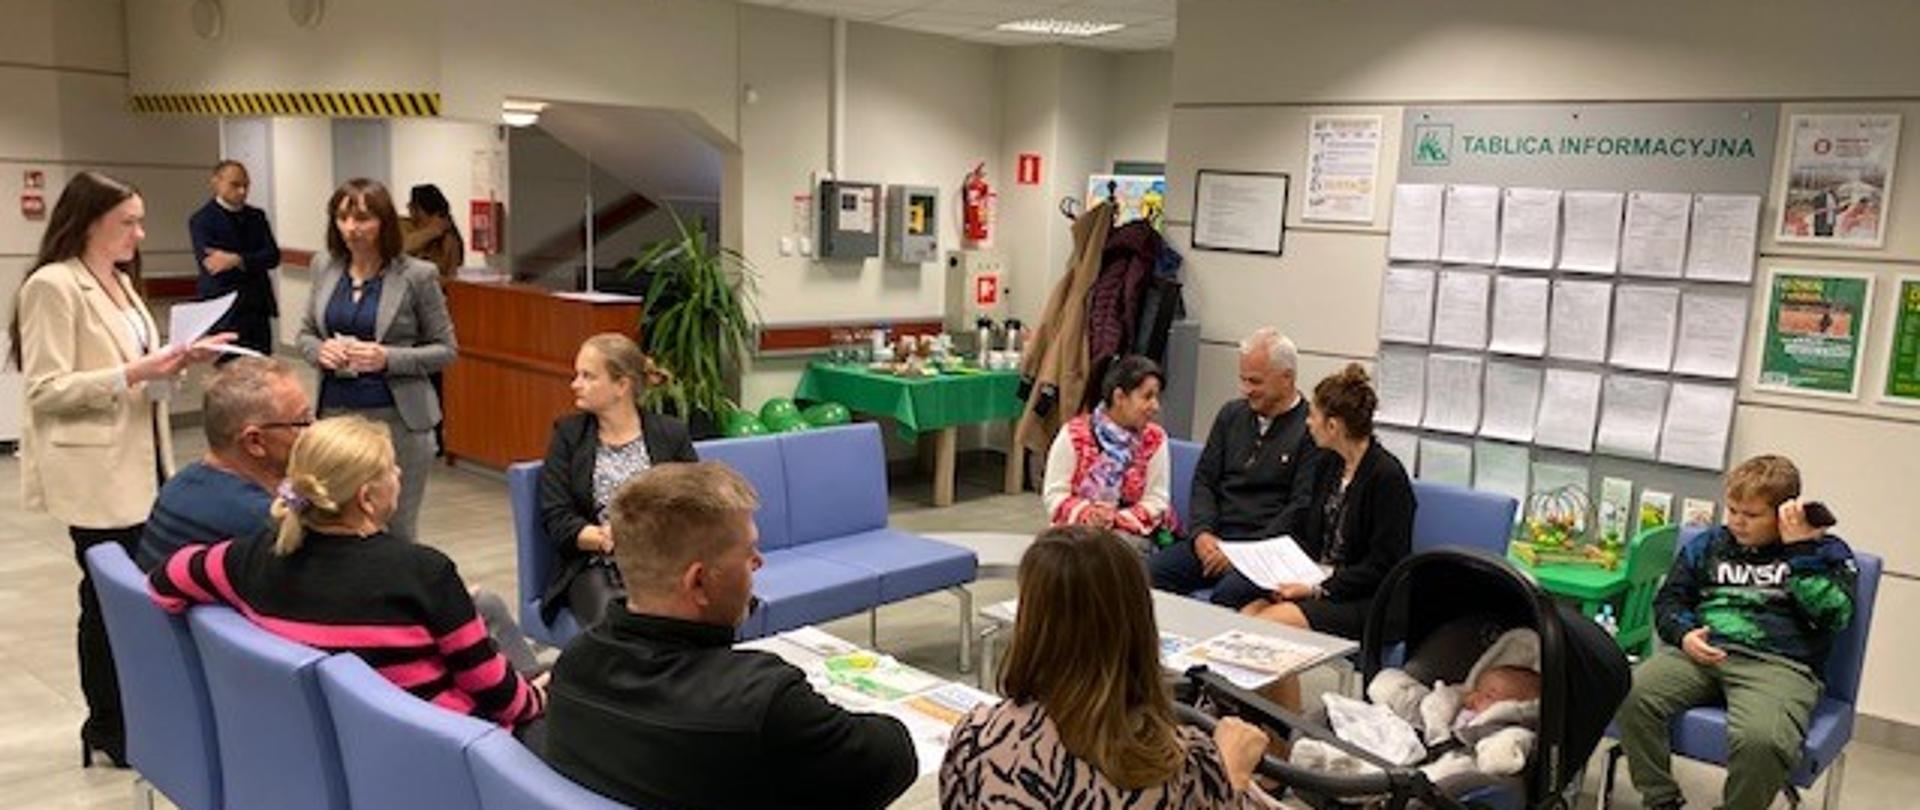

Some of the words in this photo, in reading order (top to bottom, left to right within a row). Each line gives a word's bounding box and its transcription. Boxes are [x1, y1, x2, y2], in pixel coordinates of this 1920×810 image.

[1462, 135, 1553, 156] TABLICA
[1559, 136, 1756, 159] INFORMACYJNA
[1718, 562, 1792, 584] NASA
